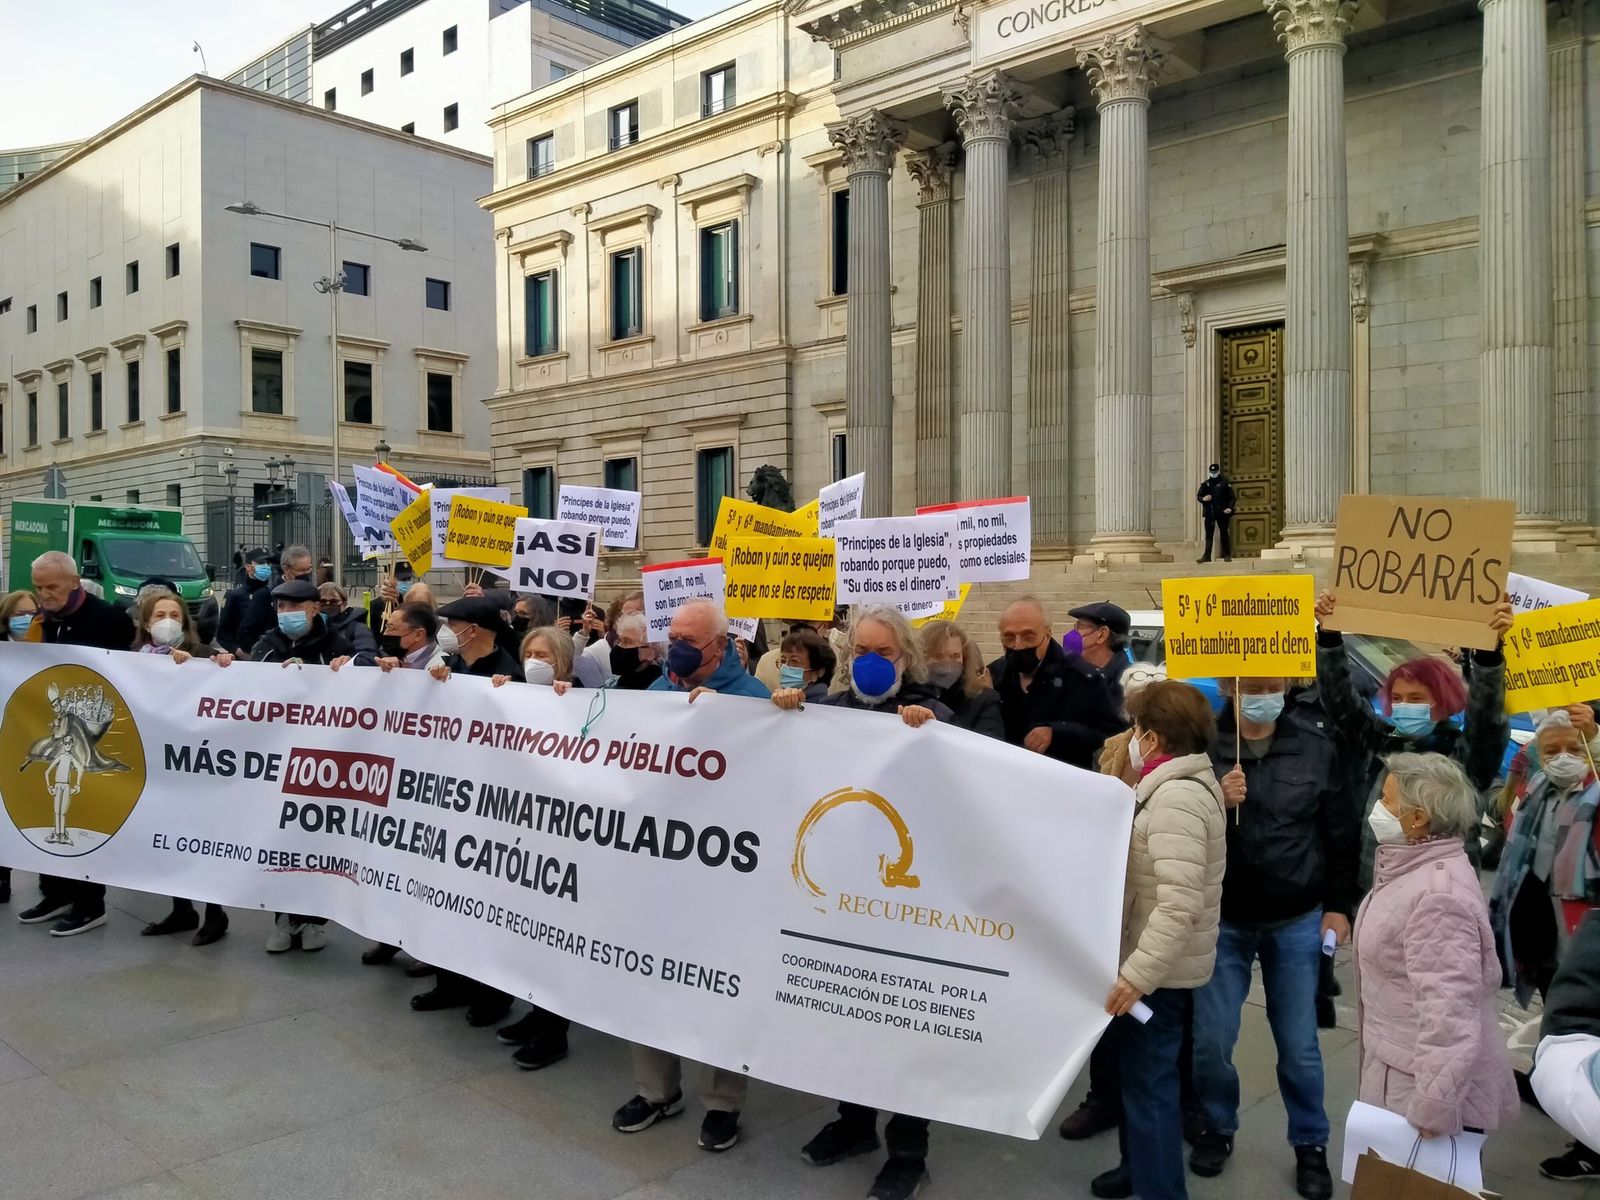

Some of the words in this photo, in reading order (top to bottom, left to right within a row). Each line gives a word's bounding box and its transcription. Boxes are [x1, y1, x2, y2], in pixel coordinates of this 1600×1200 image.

[595, 498, 602, 508] de
[604, 499, 609, 509] la
[15, 520, 49, 534] MERCADONA
[98, 519, 160, 530] MERCADONA
[477, 511, 482, 525] y
[483, 509, 494, 523] aún
[495, 513, 504, 525] se
[560, 510, 587, 522] robando
[588, 514, 614, 526] porque
[611, 515, 632, 527] puedo,
[735, 515, 743, 531] y
[961, 515, 976, 531] mil,
[978, 517, 989, 528] no
[991, 513, 1007, 528] mil,
[1387, 506, 1453, 542] NO
[448, 529, 457, 543] de
[457, 535, 469, 548] que
[471, 535, 479, 546] no
[479, 537, 487, 548] se
[488, 534, 496, 550] les
[497, 541, 514, 556] respe
[516, 531, 597, 557] ¡ASÍ
[837, 536, 886, 554] "Principes
[888, 534, 900, 549] de
[902, 533, 911, 548] la
[913, 531, 952, 551] Iglesia",
[964, 533, 1017, 551] propiedades
[731, 547, 763, 566] ¡Roban
[765, 552, 771, 569] y
[772, 546, 787, 566] aún
[790, 552, 801, 567] se
[803, 549, 834, 572] quejan
[840, 557, 880, 573] robando
[882, 559, 916, 575] porque
[918, 554, 951, 573] puedo,
[960, 556, 982, 569] como
[984, 551, 1028, 566] eclesiales.
[519, 566, 590, 593] NO!
[658, 577, 673, 591] Cien
[685, 577, 694, 587] no
[843, 578, 861, 593] "Su
[863, 577, 884, 592] dios
[886, 579, 898, 592] es
[899, 577, 908, 591] el
[911, 575, 949, 591] dinero".
[1335, 545, 1502, 605] ROBARÁS
[655, 599, 667, 610] son
[668, 596, 677, 608] las
[727, 578, 739, 598] de
[740, 583, 756, 602] que
[758, 584, 770, 598] no
[771, 585, 780, 599] se
[782, 579, 795, 599] les
[797, 582, 834, 604] respeta!
[1509, 591, 1521, 606] de
[1522, 594, 1533, 609] la
[903, 601, 910, 612] el
[1178, 594, 1190, 617] 5º
[1194, 600, 1201, 623] y
[1206, 593, 1217, 617] 6º
[1221, 592, 1299, 616] mandamientos
[650, 615, 674, 631] cogida
[1170, 631, 1197, 655] valen
[1200, 630, 1240, 655] también
[1243, 637, 1267, 661] para
[1269, 631, 1279, 654] el
[1281, 630, 1312, 654] clero.
[1510, 634, 1520, 658] y
[1521, 627, 1533, 650] 6º
[1536, 617, 1600, 648] mandamient
[1505, 668, 1529, 690] alen
[1526, 660, 1570, 687] también
[1568, 659, 1597, 687] para
[197, 697, 378, 731] RECUPERANDO
[383, 709, 462, 742] NUESTRO
[467, 720, 600, 764] PATRIMONIO
[603, 732, 727, 781] PÚBLICO
[164, 740, 237, 778] MÁS
[243, 752, 282, 782] DE
[289, 754, 389, 797] 100.000
[396, 768, 474, 813] BIENES
[475, 783, 760, 873] INMATRICULADOS
[279, 800, 346, 836] POR
[350, 807, 369, 842] LA
[368, 813, 448, 864] IGLESIA
[454, 834, 579, 902] CATÓLICA
[152, 833, 171, 850] EL
[176, 837, 252, 862] GOBIERNO
[257, 849, 301, 868] DEBE
[305, 853, 359, 878] CUMPLIR
[360, 866, 384, 888] CON
[385, 873, 402, 893] EL
[406, 877, 484, 920] COMPROMISO
[487, 903, 503, 927] DE
[505, 910, 586, 958] RECUPERAR
[589, 940, 655, 977] ESTOS
[660, 957, 742, 999] BIENES
[837, 892, 1015, 941] RECUPERANDO
[781, 953, 877, 983] COORDINADORA
[880, 972, 935, 995] ESTATAL
[941, 984, 968, 1001] POR
[970, 989, 988, 1004] LA
[787, 973, 880, 1003] RECUPERACIÓN
[882, 993, 899, 1008] DE
[902, 996, 927, 1013] LOS
[929, 1002, 976, 1022] BIENES
[775, 990, 882, 1024] INMATRICULADOS
[884, 1014, 911, 1030] POR
[913, 1019, 931, 1034] LA
[933, 1023, 983, 1044] IGLESIA
